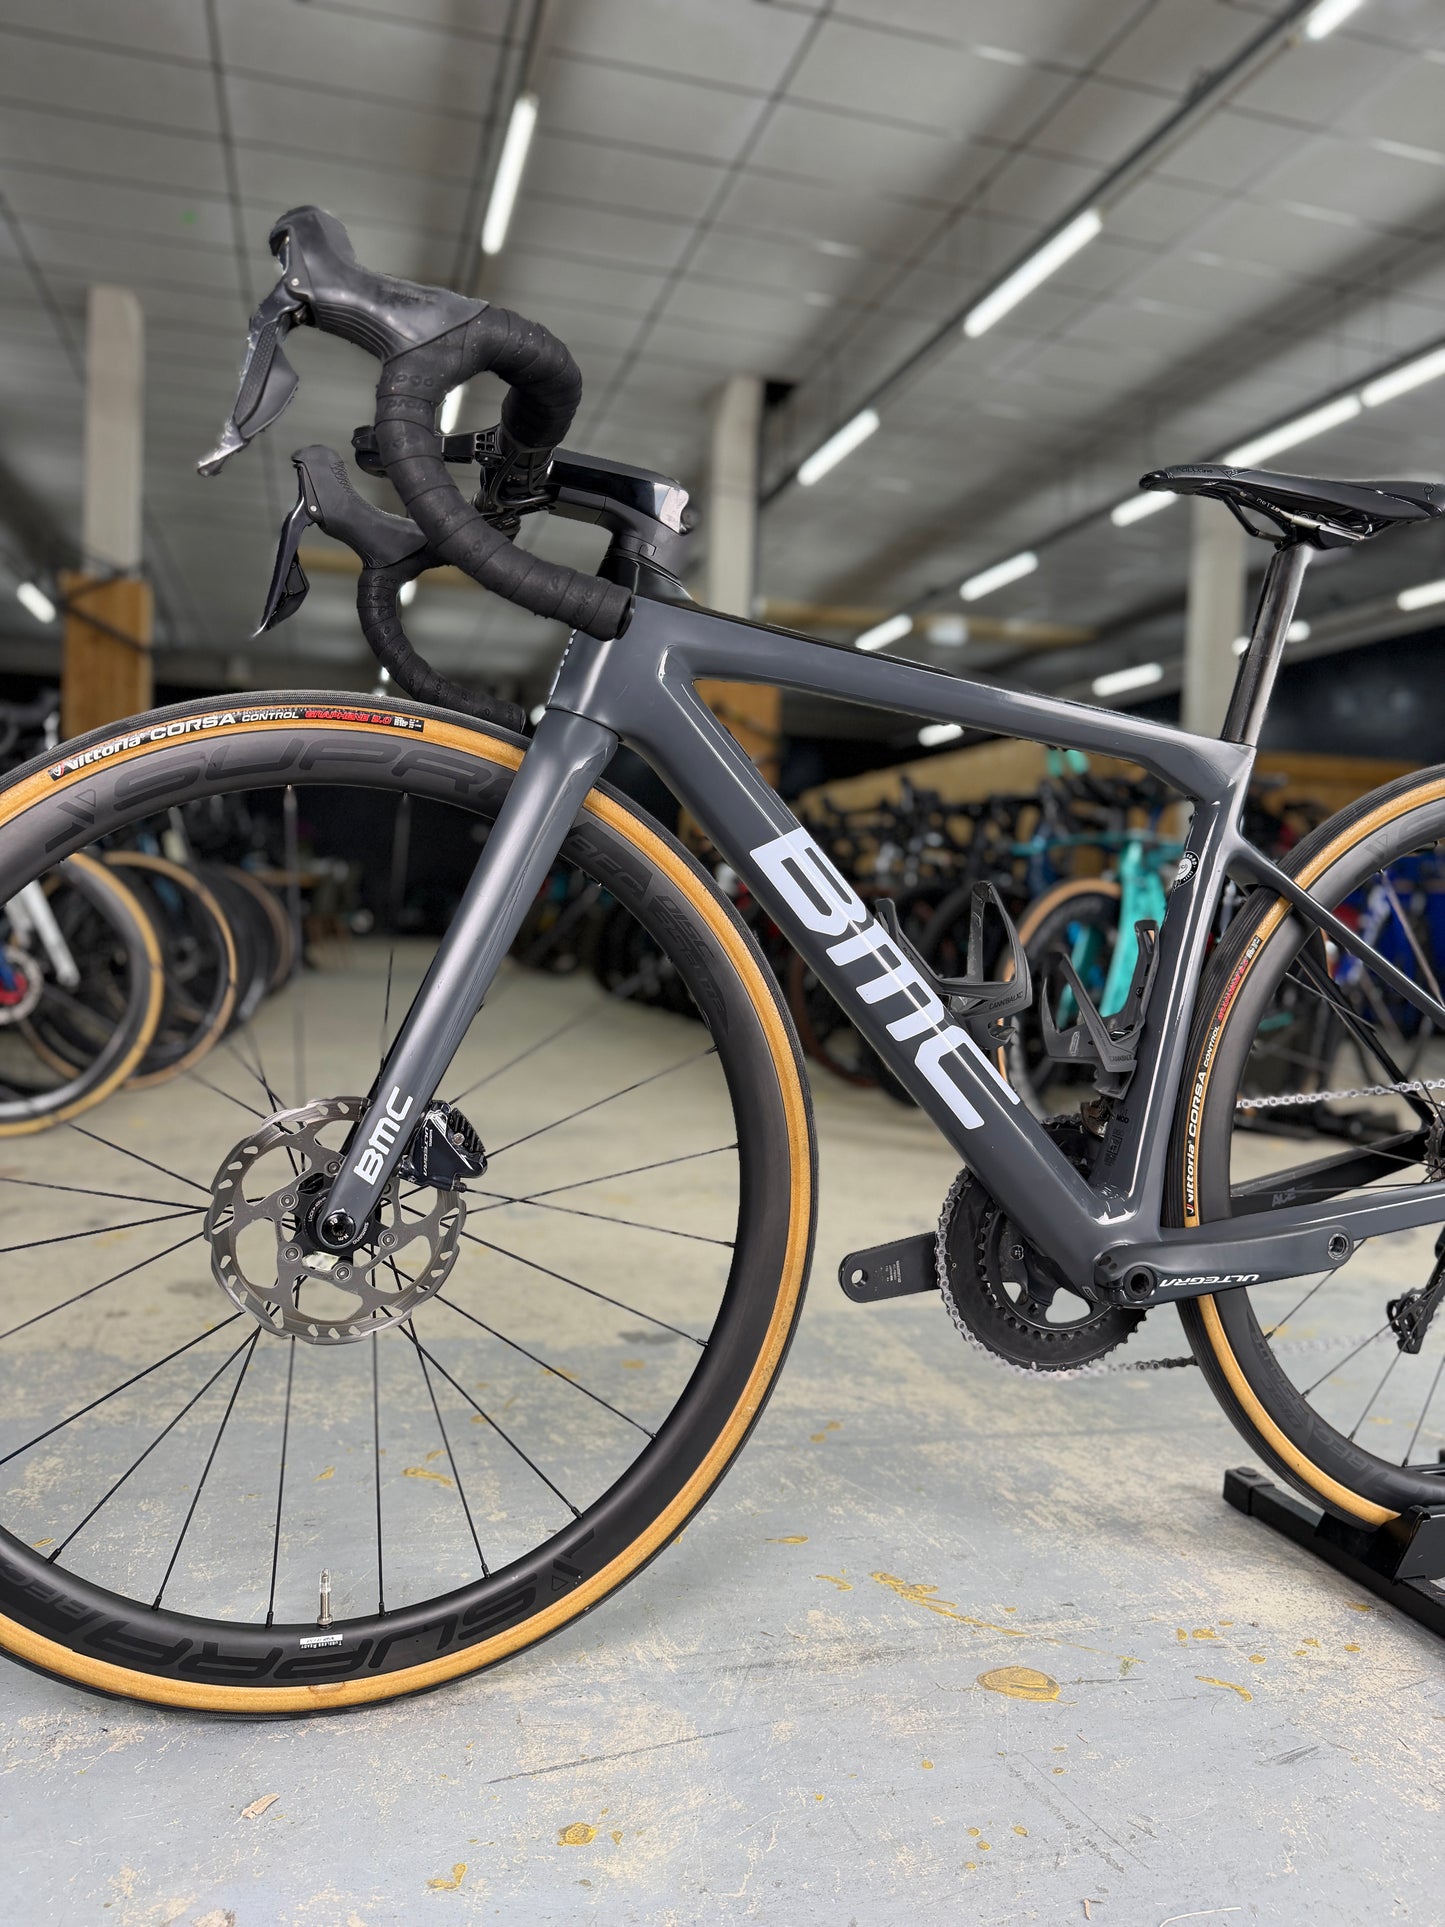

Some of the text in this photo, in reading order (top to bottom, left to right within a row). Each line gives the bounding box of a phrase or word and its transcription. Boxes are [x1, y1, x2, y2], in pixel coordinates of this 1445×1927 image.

[150, 713, 236, 741] CORSA
[241, 711, 299, 722] CONTROL
[749, 826, 1021, 1130] BMC
[1188, 1071, 1207, 1138] CORSA
[1203, 1025, 1220, 1068] CONTROL
[353, 1085, 414, 1186] BMC
[1159, 1273, 1260, 1288] ULTEGRA
